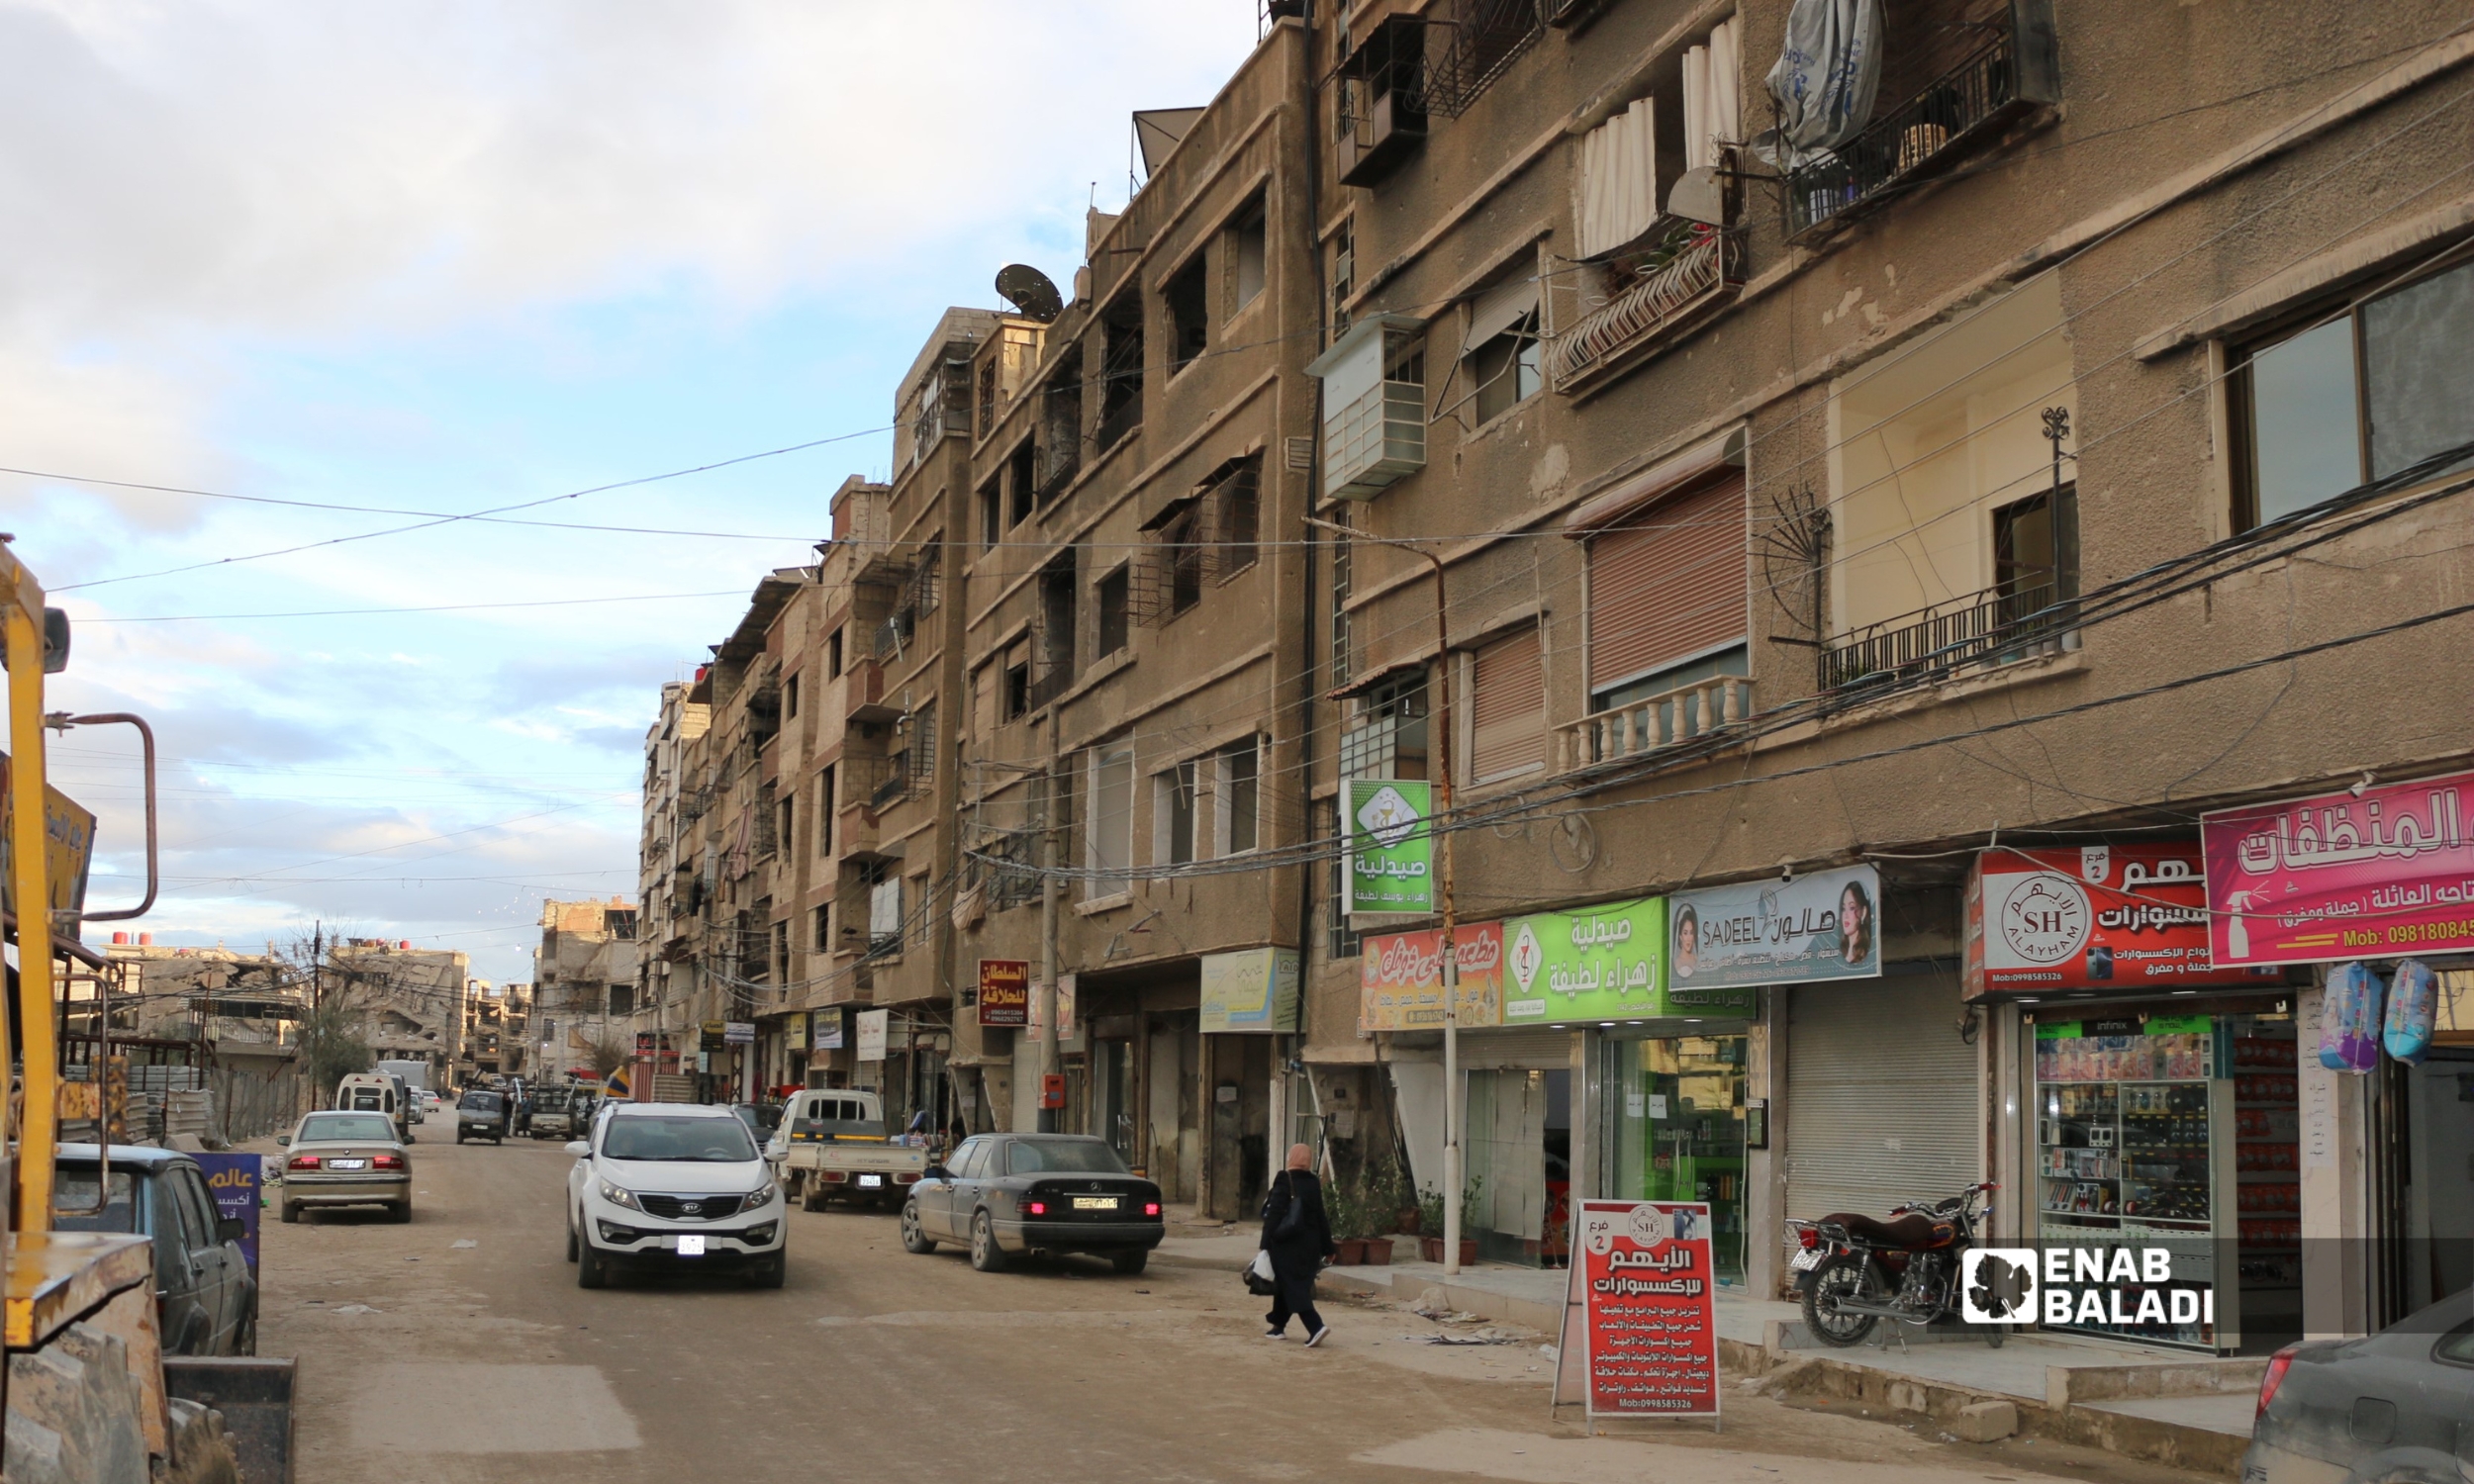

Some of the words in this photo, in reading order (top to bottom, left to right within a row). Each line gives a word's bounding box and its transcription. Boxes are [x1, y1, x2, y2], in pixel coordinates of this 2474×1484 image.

[2238, 788, 2460, 875] المنظفات
[2086, 852, 2106, 864] فرع
[1355, 854, 1427, 880] صيدلية
[2091, 866, 2101, 879] 2
[1355, 888, 1379, 901] لطيفة
[1380, 891, 1404, 902] يوسف
[1406, 891, 1428, 903] زهراء
[2372, 883, 2431, 908] العائلة
[1770, 907, 1836, 944] صالون
[2024, 910, 2063, 934] SH
[1571, 915, 1631, 952] صيدلية
[1703, 916, 1760, 948] SADEEL
[2343, 929, 2384, 947] Mob:
[2008, 925, 2079, 957] ALAYHAM
[981, 964, 1026, 983] السلطان
[1605, 955, 1657, 994] زهراء
[2145, 964, 2174, 975] مفرق
[1550, 960, 1600, 998] لطيفة
[982, 985, 1026, 1004] للحلاقة
[1670, 990, 1710, 1007] لطيفة
[1714, 991, 1750, 1007] زهراء
[209, 1168, 252, 1187] عالم
[1589, 1220, 1608, 1233] فرع
[1637, 1223, 1654, 1233] SH
[1632, 1228, 1661, 1243] ALAYHAM
[1594, 1236, 1604, 1250] 2
[1608, 1245, 1690, 1272] الأيهم
[1593, 1276, 1701, 1296] للإكسسوارات
[1624, 1307, 1634, 1317] مع
[1635, 1305, 1659, 1317] البرامج
[1661, 1307, 1676, 1317] جميع
[1677, 1305, 1700, 1317] تنزيل
[1665, 1324, 1682, 1333] جميع
[1683, 1320, 1701, 1333] شحن
[1671, 1338, 1692, 1348] جميع
[1693, 1354, 1708, 1364] جميع
[1595, 1365, 1617, 1376] حلاقة
[1682, 1383, 1707, 1395] تسديد
[1619, 1398, 1692, 1409] Mob:0998585326
